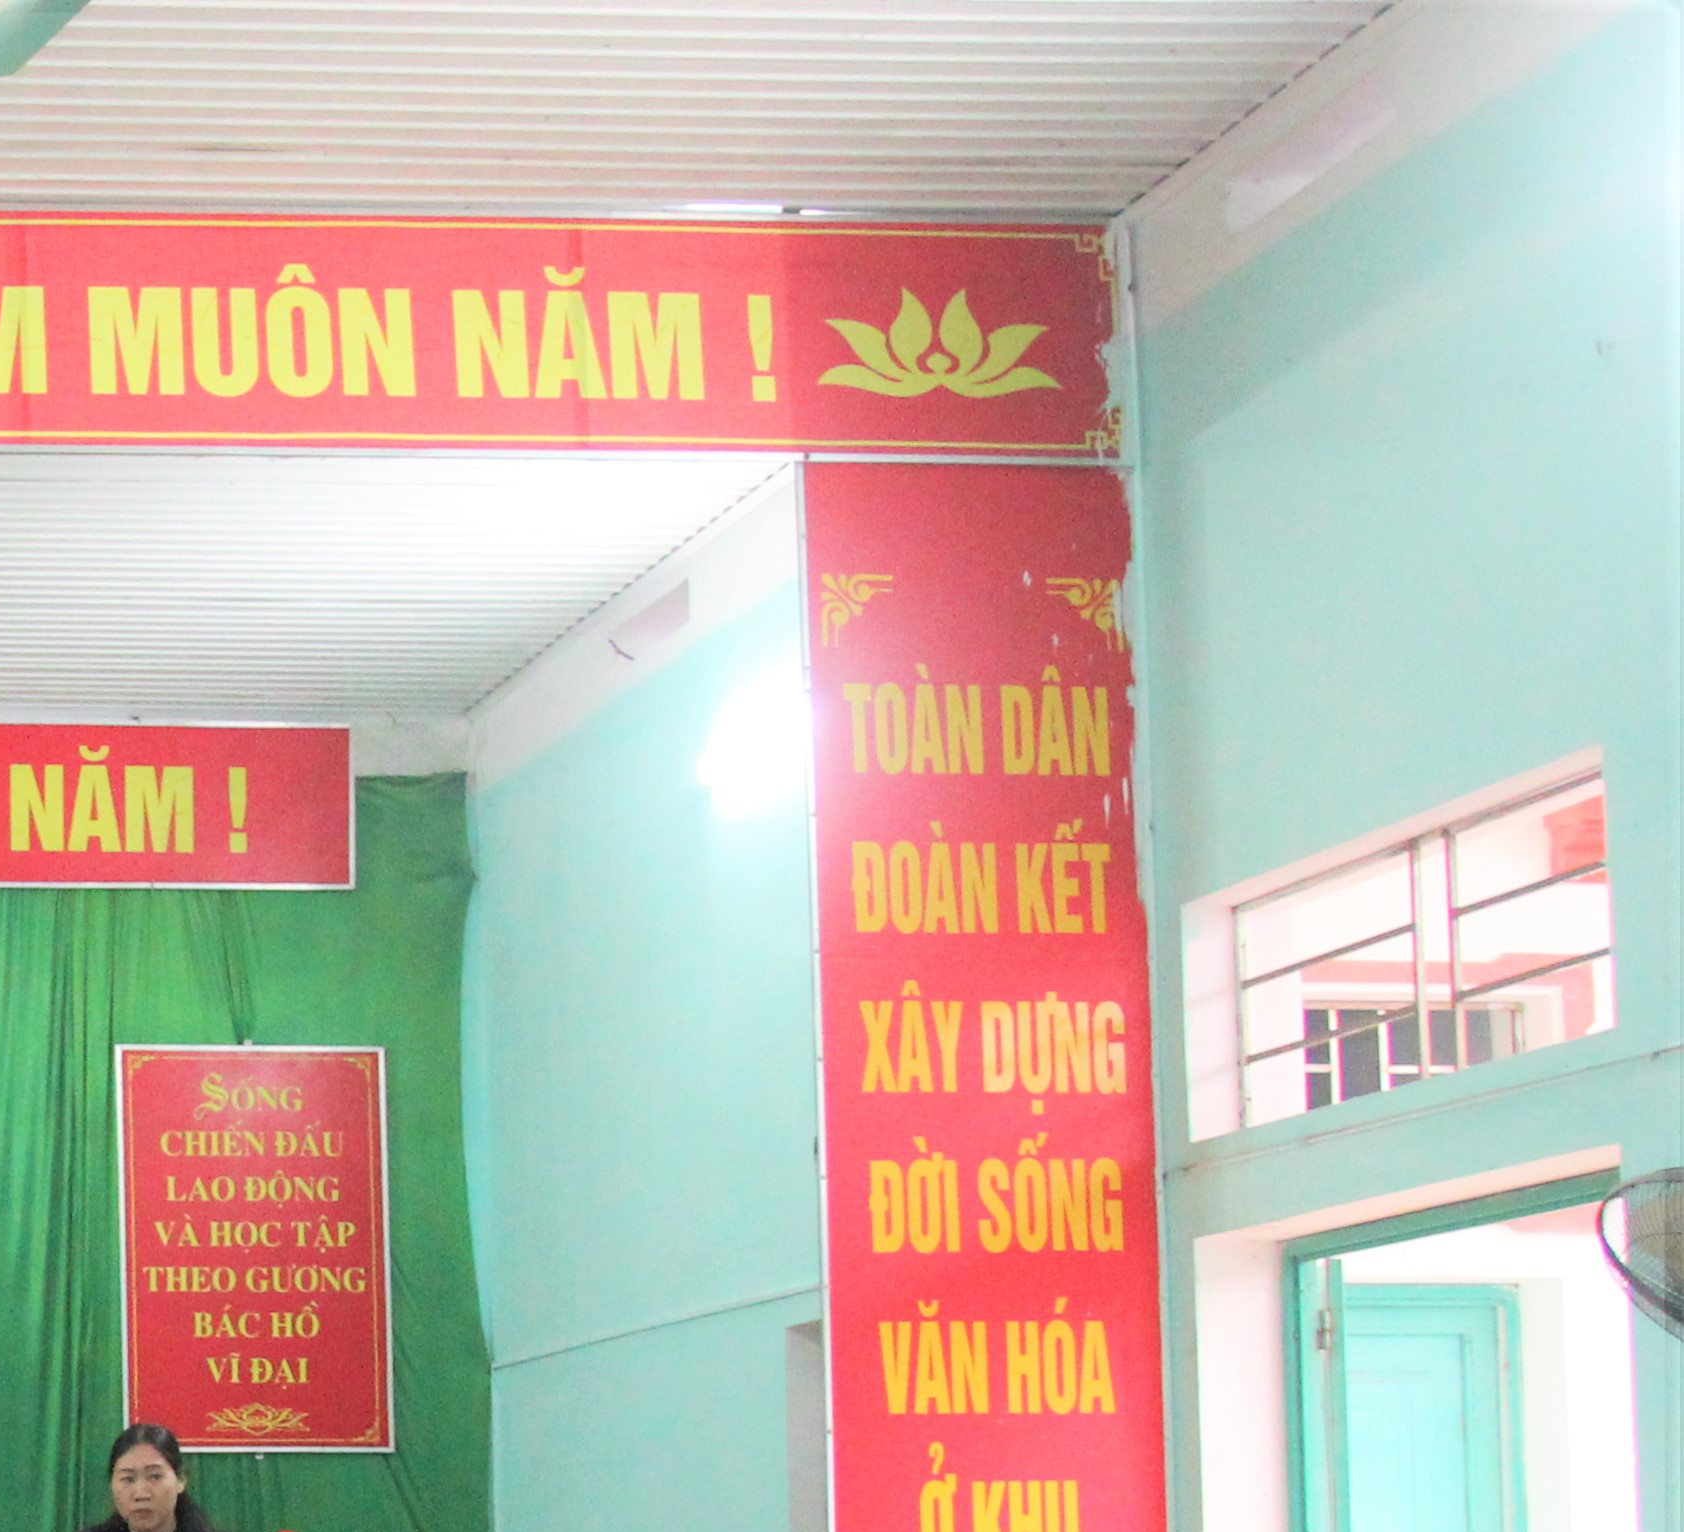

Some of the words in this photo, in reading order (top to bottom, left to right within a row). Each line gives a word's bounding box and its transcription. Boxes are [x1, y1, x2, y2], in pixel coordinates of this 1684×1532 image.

[90, 264, 415, 398] MUÔN
[452, 266, 707, 401] NĂM
[747, 294, 778, 402] !
[842, 663, 984, 776] TOÀN
[1001, 665, 1112, 777] DÂN
[8, 743, 195, 855] NĂM
[226, 766, 250, 854] !
[851, 821, 999, 934] ĐOÀN
[1015, 818, 1112, 935] KẾT
[859, 979, 963, 1094] XÂY
[980, 991, 1128, 1115] DỰNG
[193, 1071, 304, 1121] SỐNG
[159, 1120, 266, 1158] CHIẾN
[273, 1120, 345, 1158] ĐẤU
[165, 1175, 236, 1203] LAO
[243, 1169, 341, 1209] ĐỘNG
[868, 1136, 961, 1254] ĐỜI
[977, 1132, 1125, 1254] SỐNG
[153, 1213, 201, 1248] VÀ
[209, 1219, 283, 1254] HỌC
[290, 1214, 357, 1255] TẬP
[142, 1266, 237, 1294] THEO
[245, 1263, 368, 1294] GƯƠNG
[193, 1302, 261, 1338] BÁC
[270, 1299, 321, 1338] HỒ
[206, 1352, 241, 1384] VĨ
[249, 1357, 310, 1391] ĐẠI
[878, 1299, 990, 1415] VĂN
[1006, 1297, 1117, 1414] HÓA
